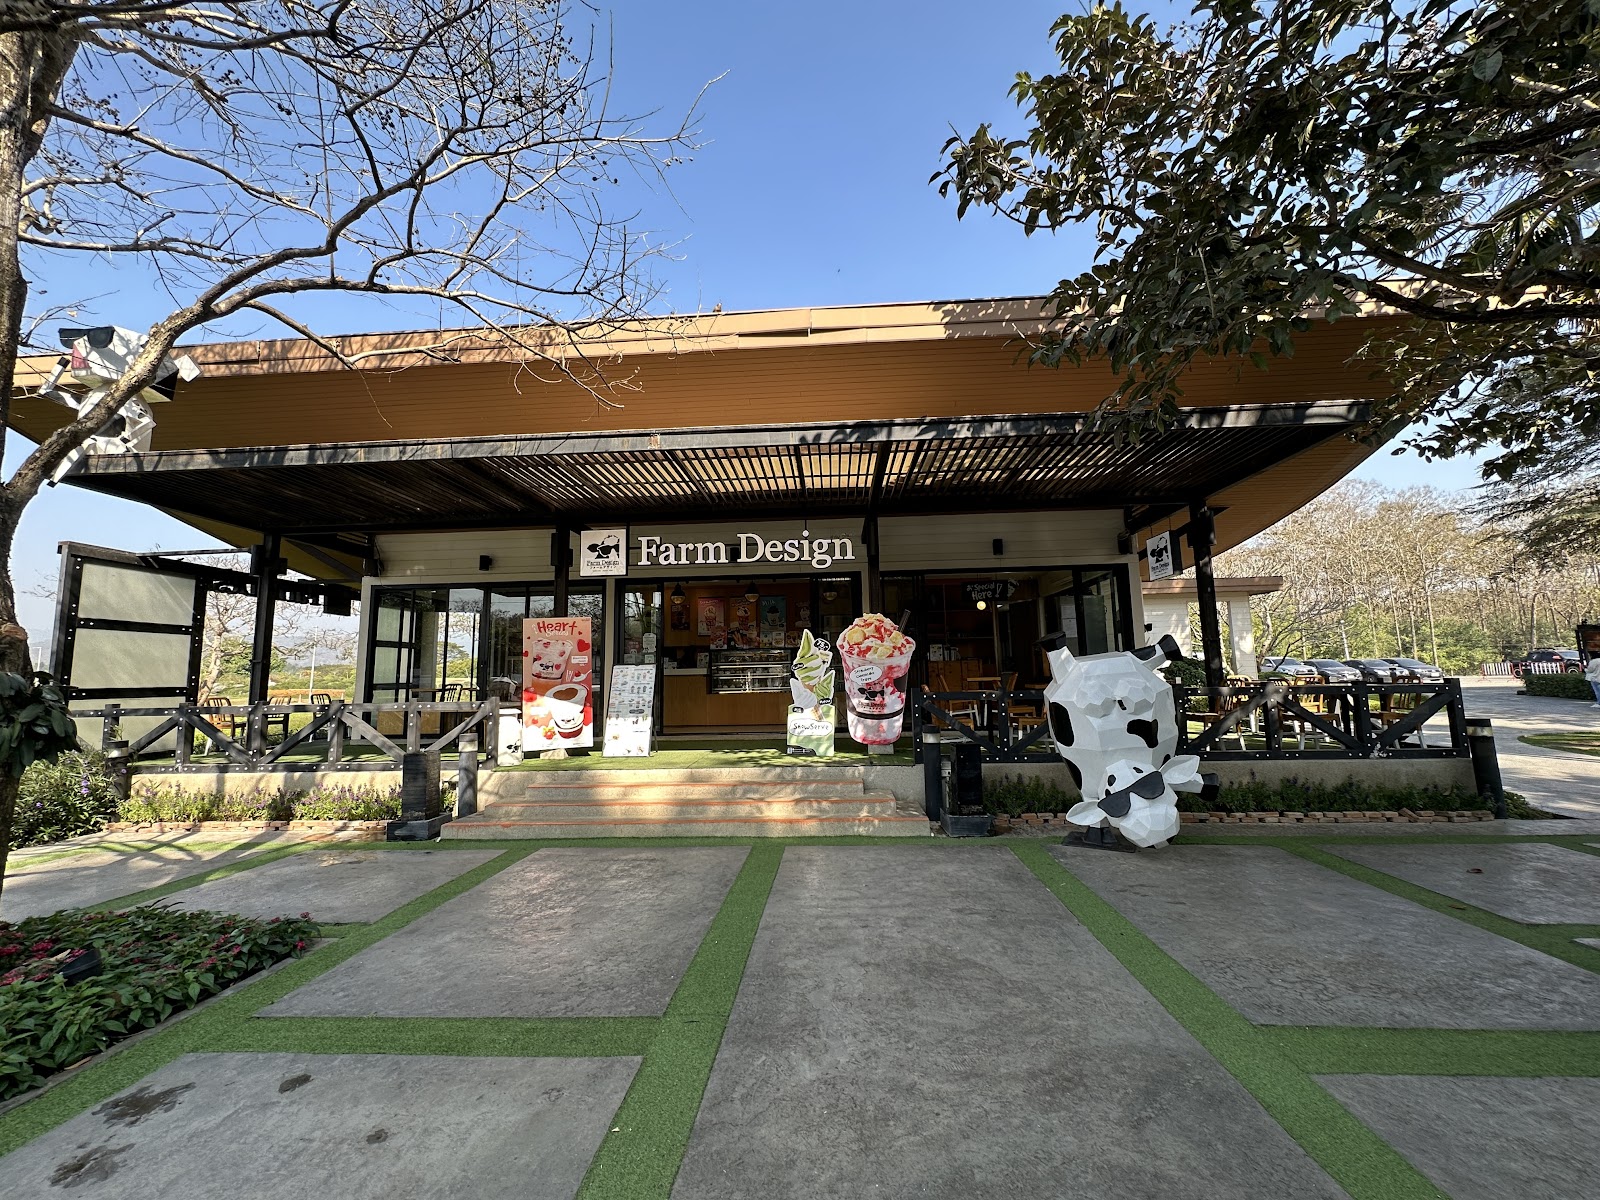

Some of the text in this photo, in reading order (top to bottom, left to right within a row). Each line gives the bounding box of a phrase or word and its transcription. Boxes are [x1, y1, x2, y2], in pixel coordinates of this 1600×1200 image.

[638, 529, 856, 569] Farm Design
[971, 590, 993, 600] Here
[536, 620, 578, 635] Heart
